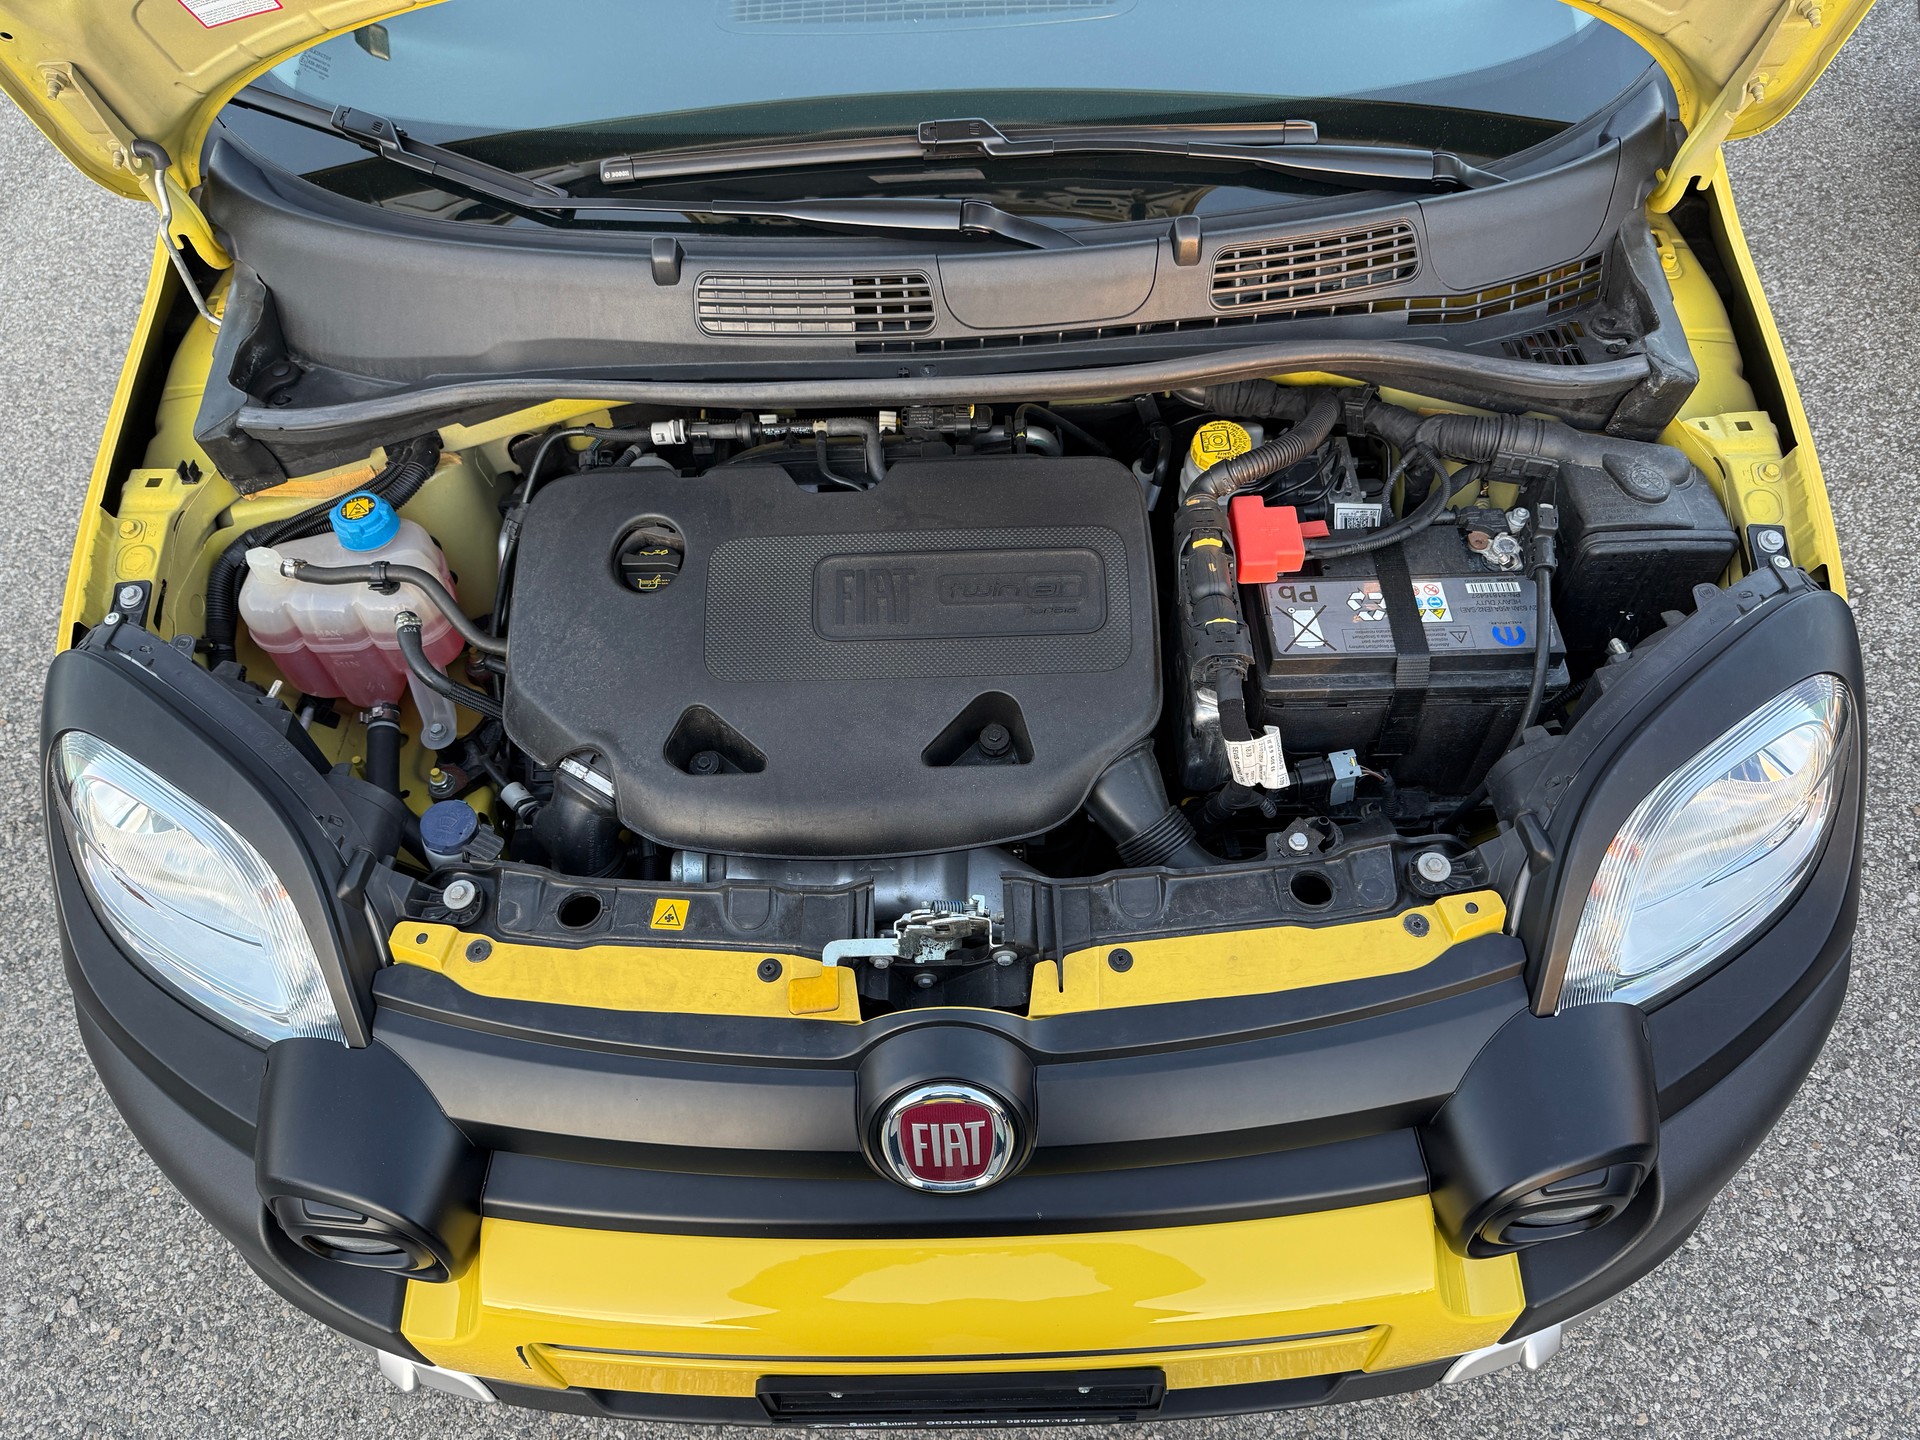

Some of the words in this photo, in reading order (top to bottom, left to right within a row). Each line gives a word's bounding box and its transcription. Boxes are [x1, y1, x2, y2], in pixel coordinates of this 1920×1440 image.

[833, 567, 917, 625] FIAT
[1278, 585, 1319, 603] Pb
[911, 1120, 986, 1167] FIAT
